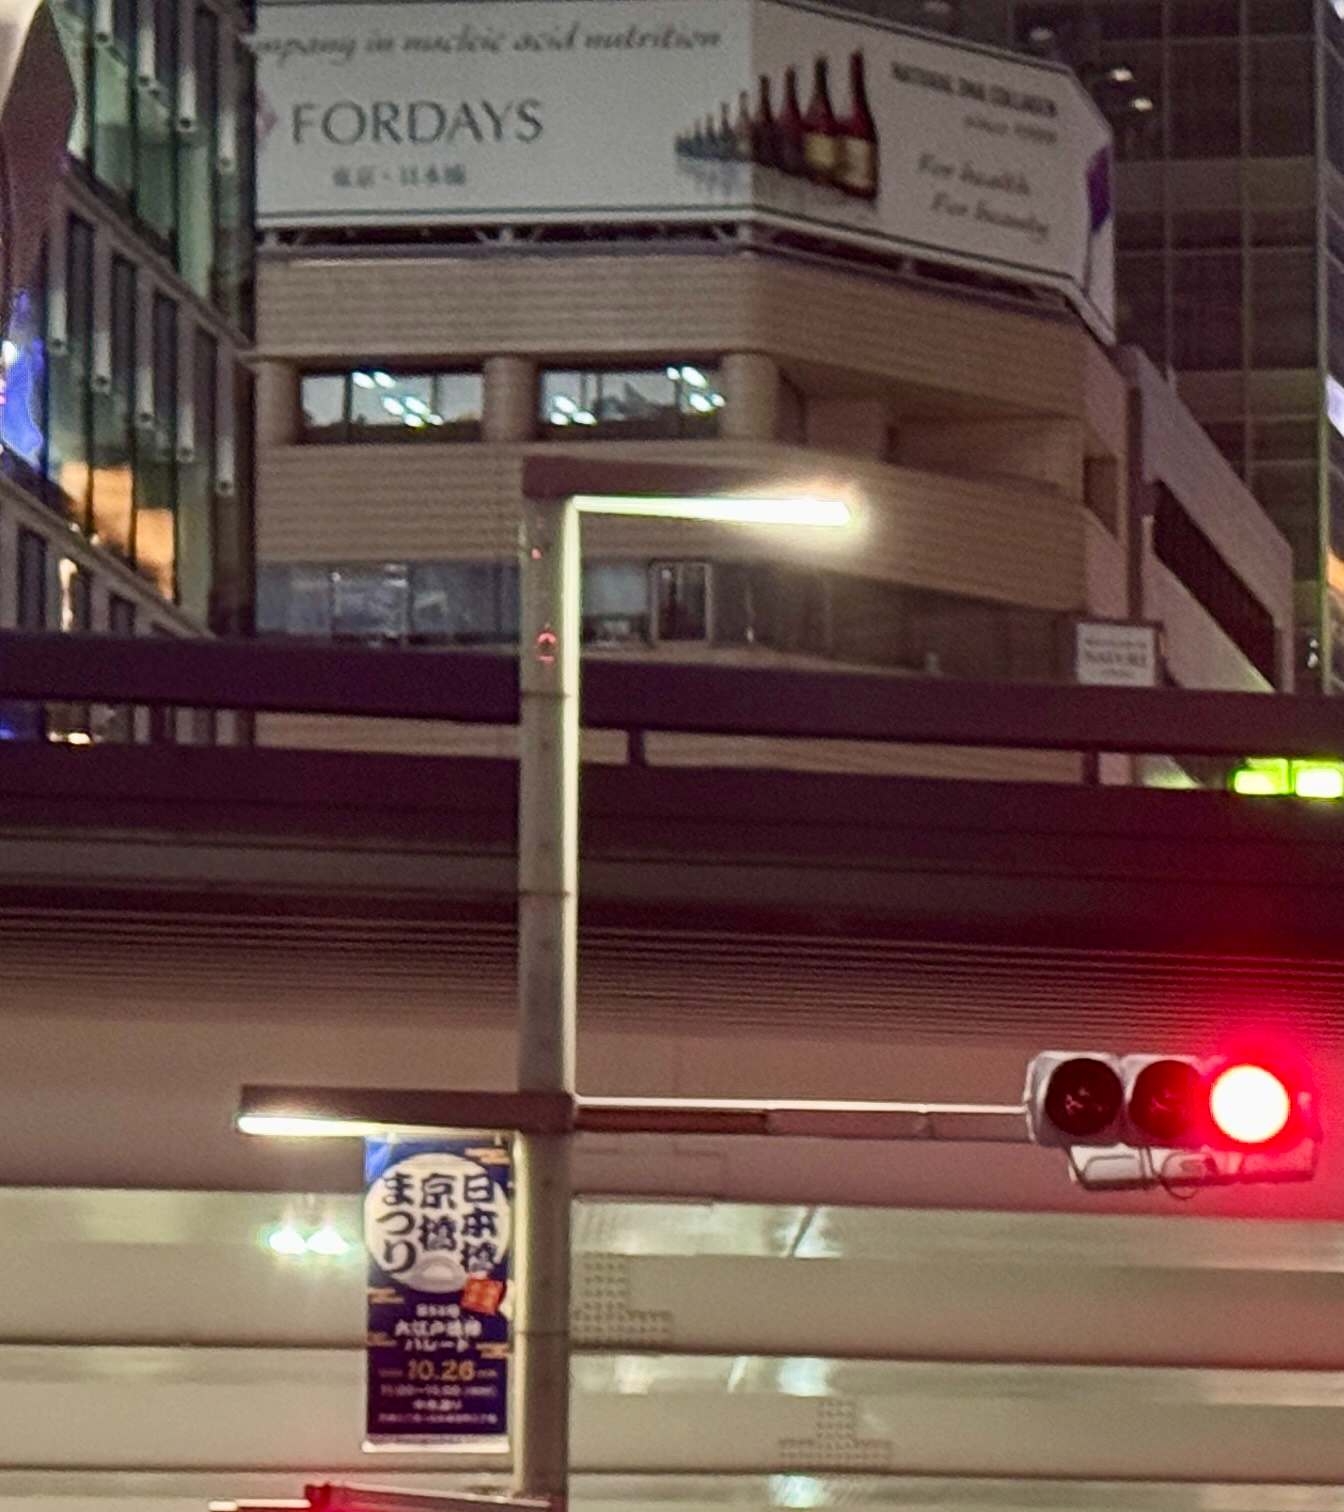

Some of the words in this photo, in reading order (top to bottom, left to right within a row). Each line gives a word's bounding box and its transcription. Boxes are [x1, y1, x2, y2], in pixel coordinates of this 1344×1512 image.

[365, 30, 394, 54] in
[402, 25, 500, 54] nucleic
[513, 22, 579, 52] acid
[584, 24, 722, 51] nutrition
[291, 99, 544, 146] FORDAYS
[376, 1172, 416, 1274] まつり
[419, 1173, 457, 1252] 京橋
[461, 1173, 498, 1273] 日本橋
[407, 1359, 475, 1381] 10.26
